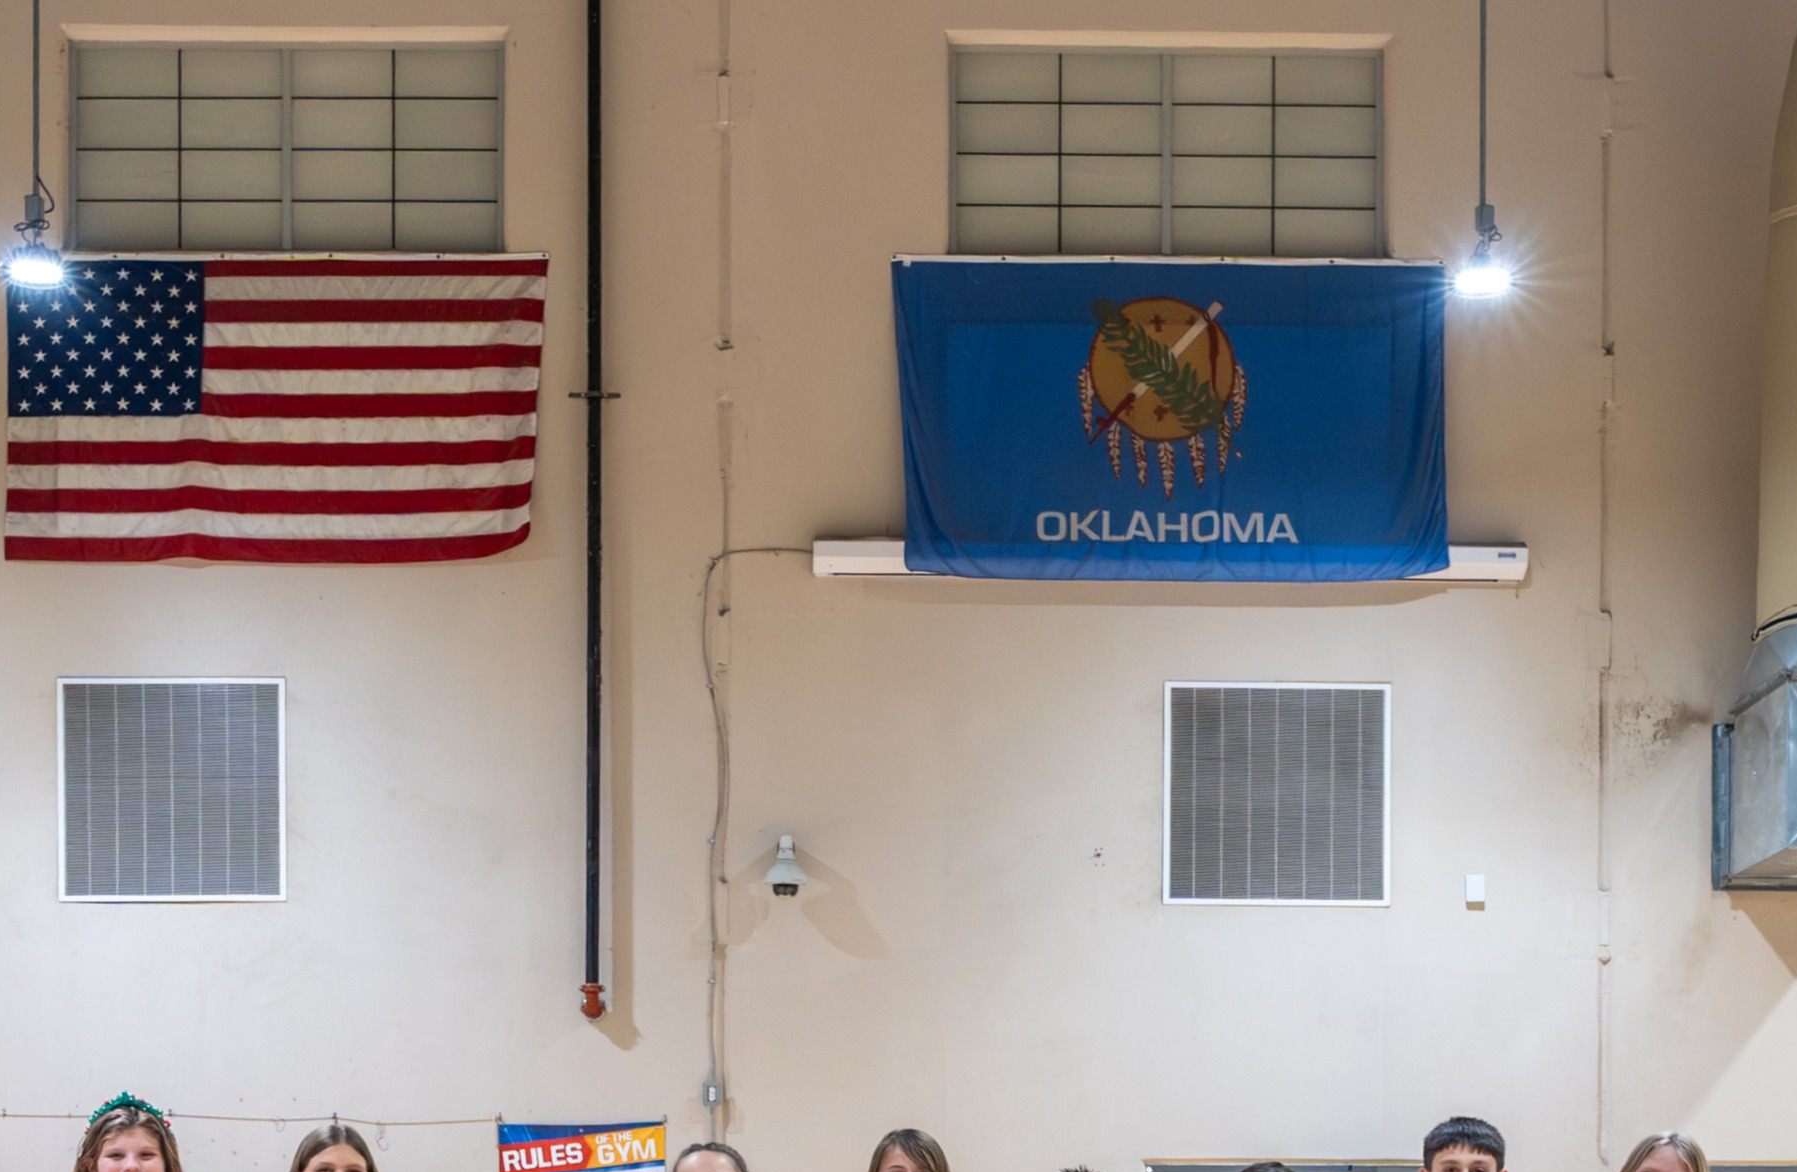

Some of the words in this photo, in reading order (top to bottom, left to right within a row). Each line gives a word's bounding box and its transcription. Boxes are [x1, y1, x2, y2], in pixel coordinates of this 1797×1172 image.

[1036, 509, 1299, 544] OKLAHOMA
[595, 1133, 610, 1145] OF
[612, 1130, 633, 1142] THE
[597, 1138, 657, 1165] GYM
[502, 1142, 584, 1172] RULES
